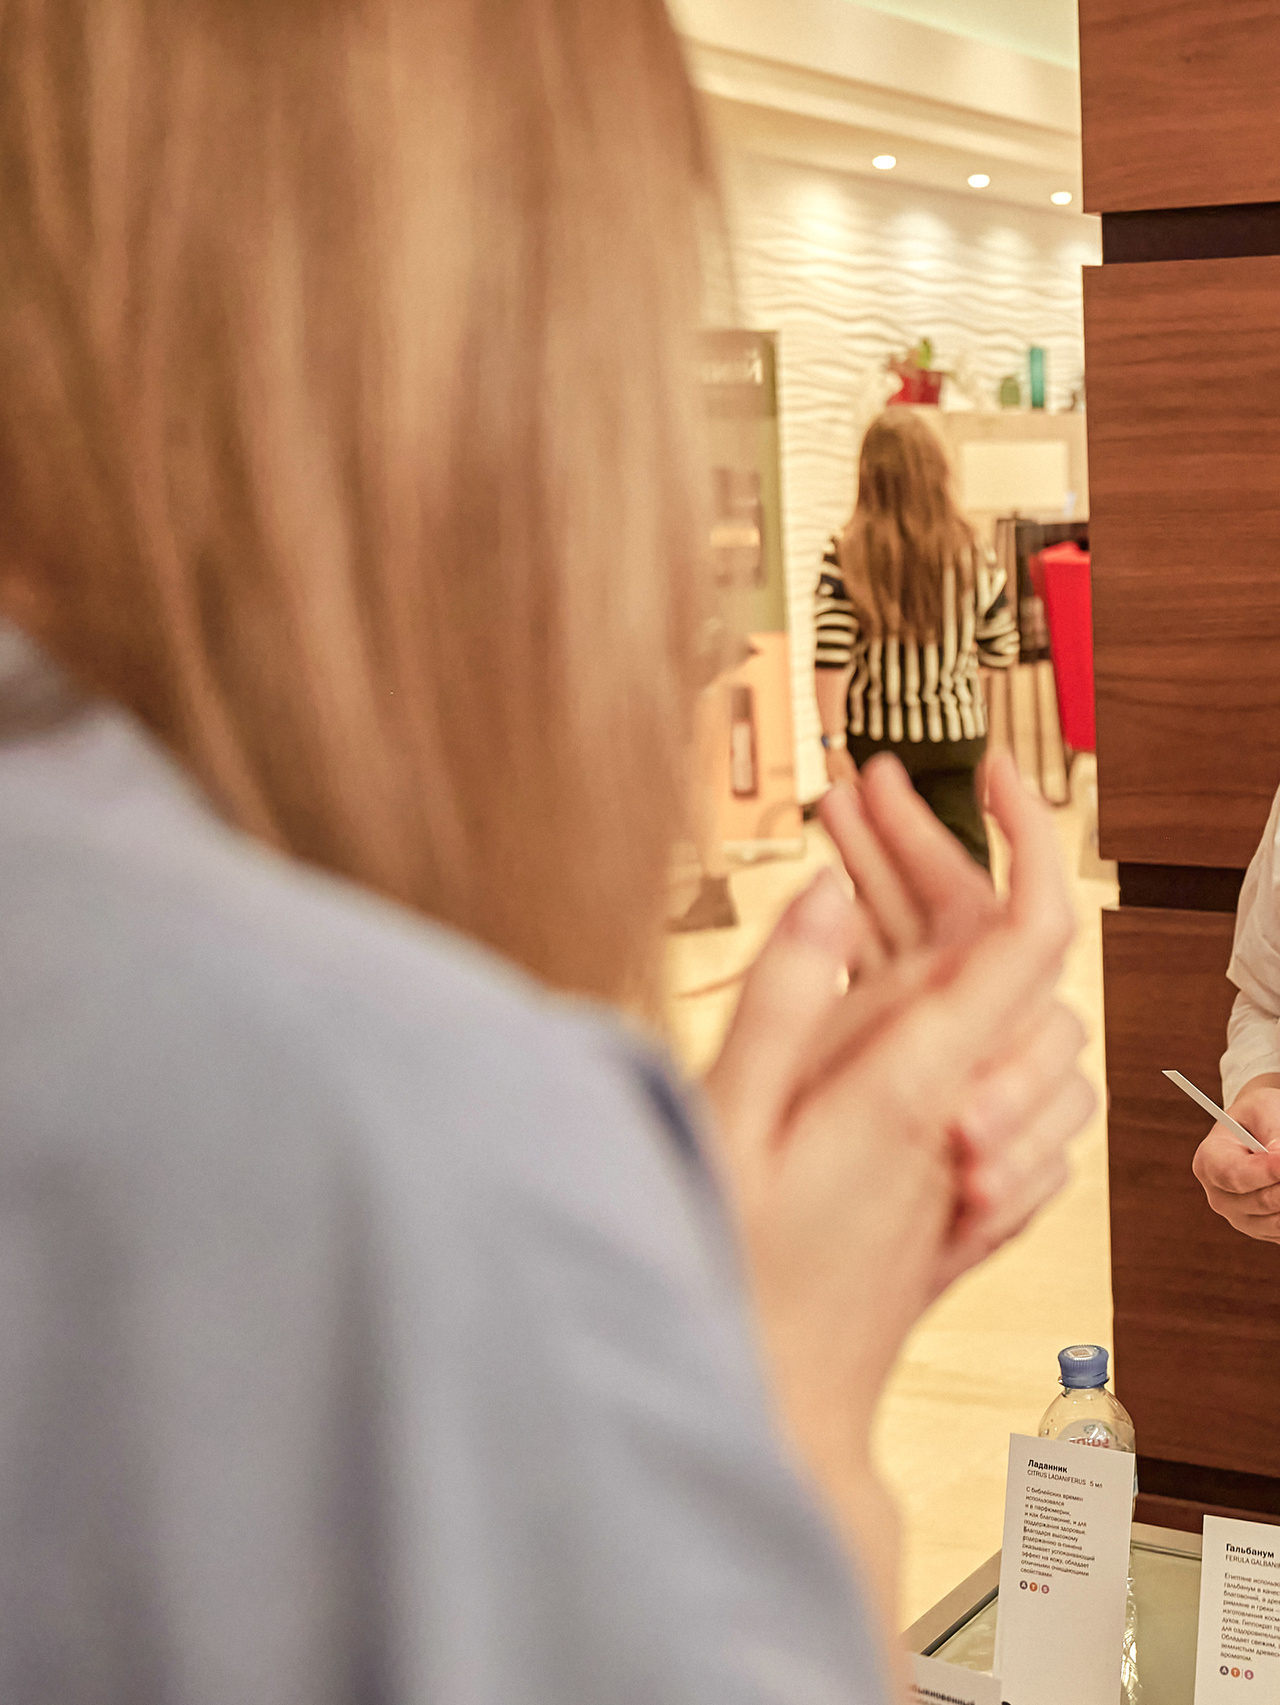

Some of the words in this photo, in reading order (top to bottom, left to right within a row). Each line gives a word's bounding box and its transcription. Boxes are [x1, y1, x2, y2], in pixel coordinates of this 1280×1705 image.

[1028, 1460, 1067, 1473] Ладанник
[1226, 1544, 1274, 1558] Гальбанум
[1226, 1554, 1250, 1564] FERULA
